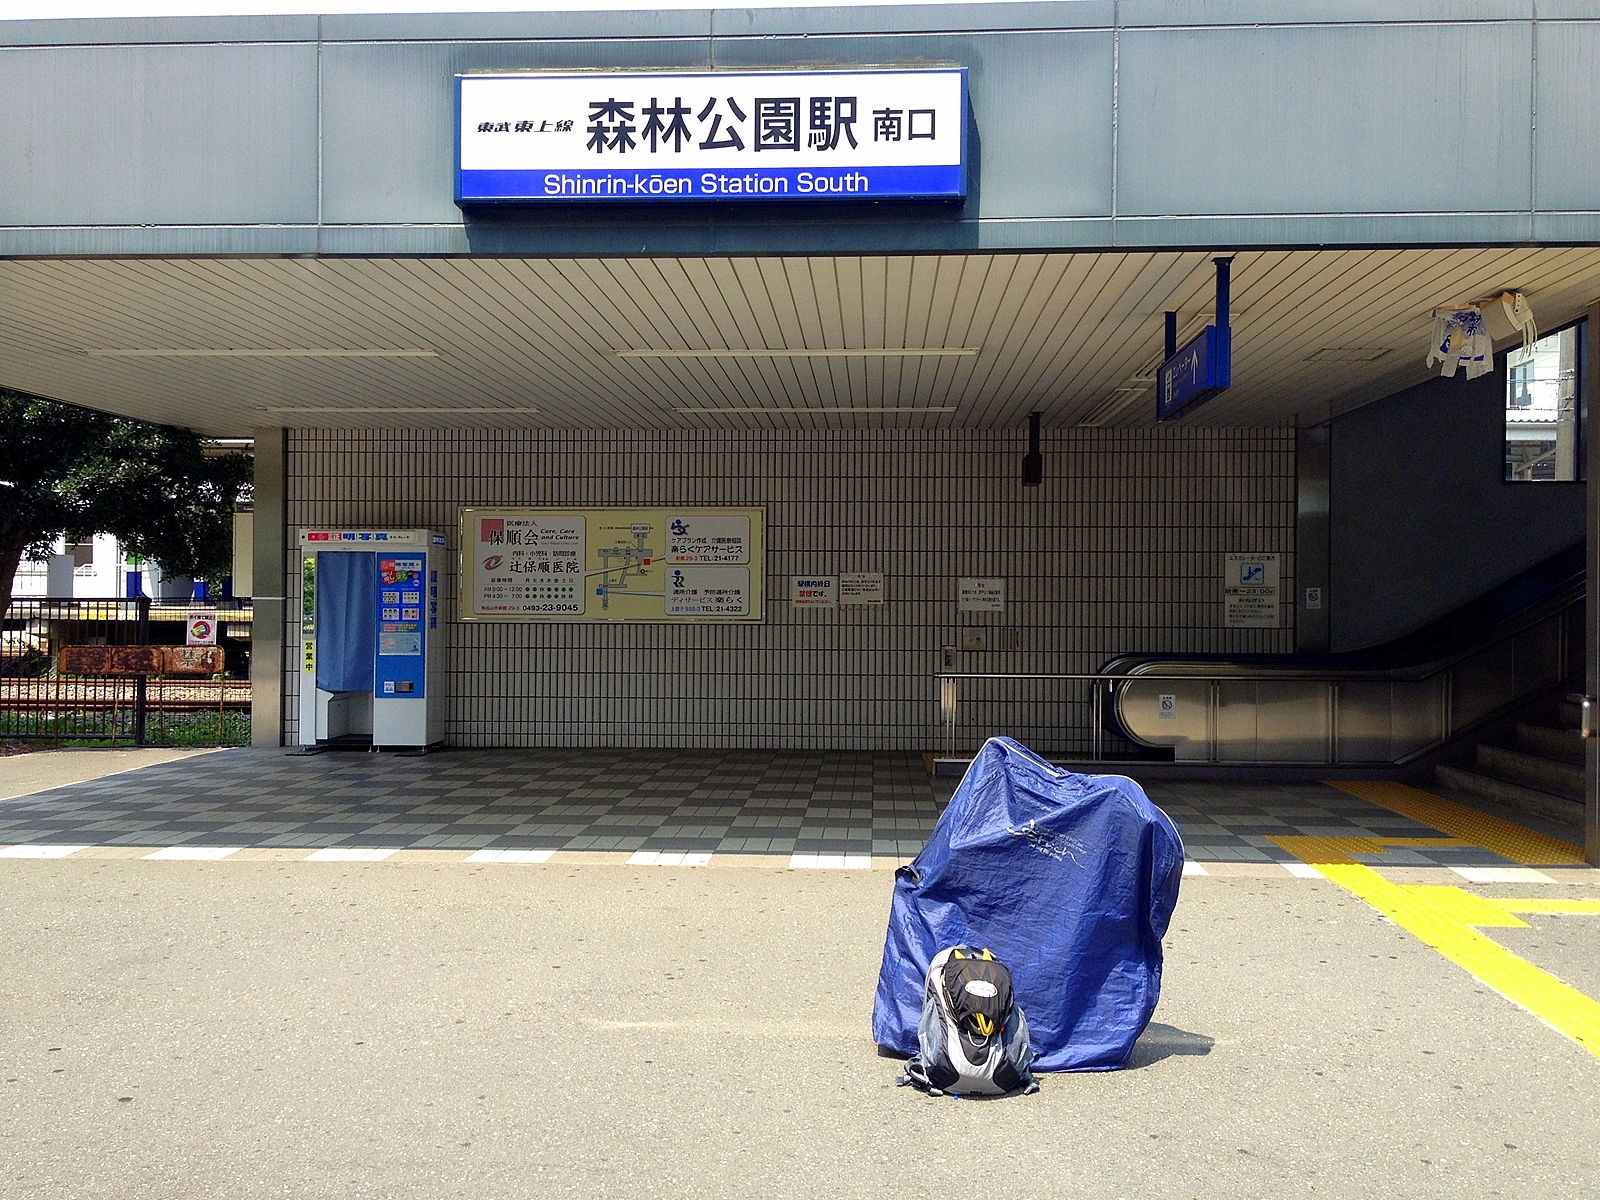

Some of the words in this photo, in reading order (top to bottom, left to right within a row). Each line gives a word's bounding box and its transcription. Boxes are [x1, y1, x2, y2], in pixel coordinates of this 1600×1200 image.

[478, 120, 574, 133] 東武東上線
[587, 96, 859, 153] 森林公園駅
[873, 107, 937, 142] 南口
[544, 174, 692, 195] Shinrin-kōen
[701, 173, 788, 195] Station
[797, 172, 870, 194] South
[490, 529, 539, 546] 保順会
[523, 604, 579, 612] 0493-23-9045
[305, 642, 313, 671] 営業中
